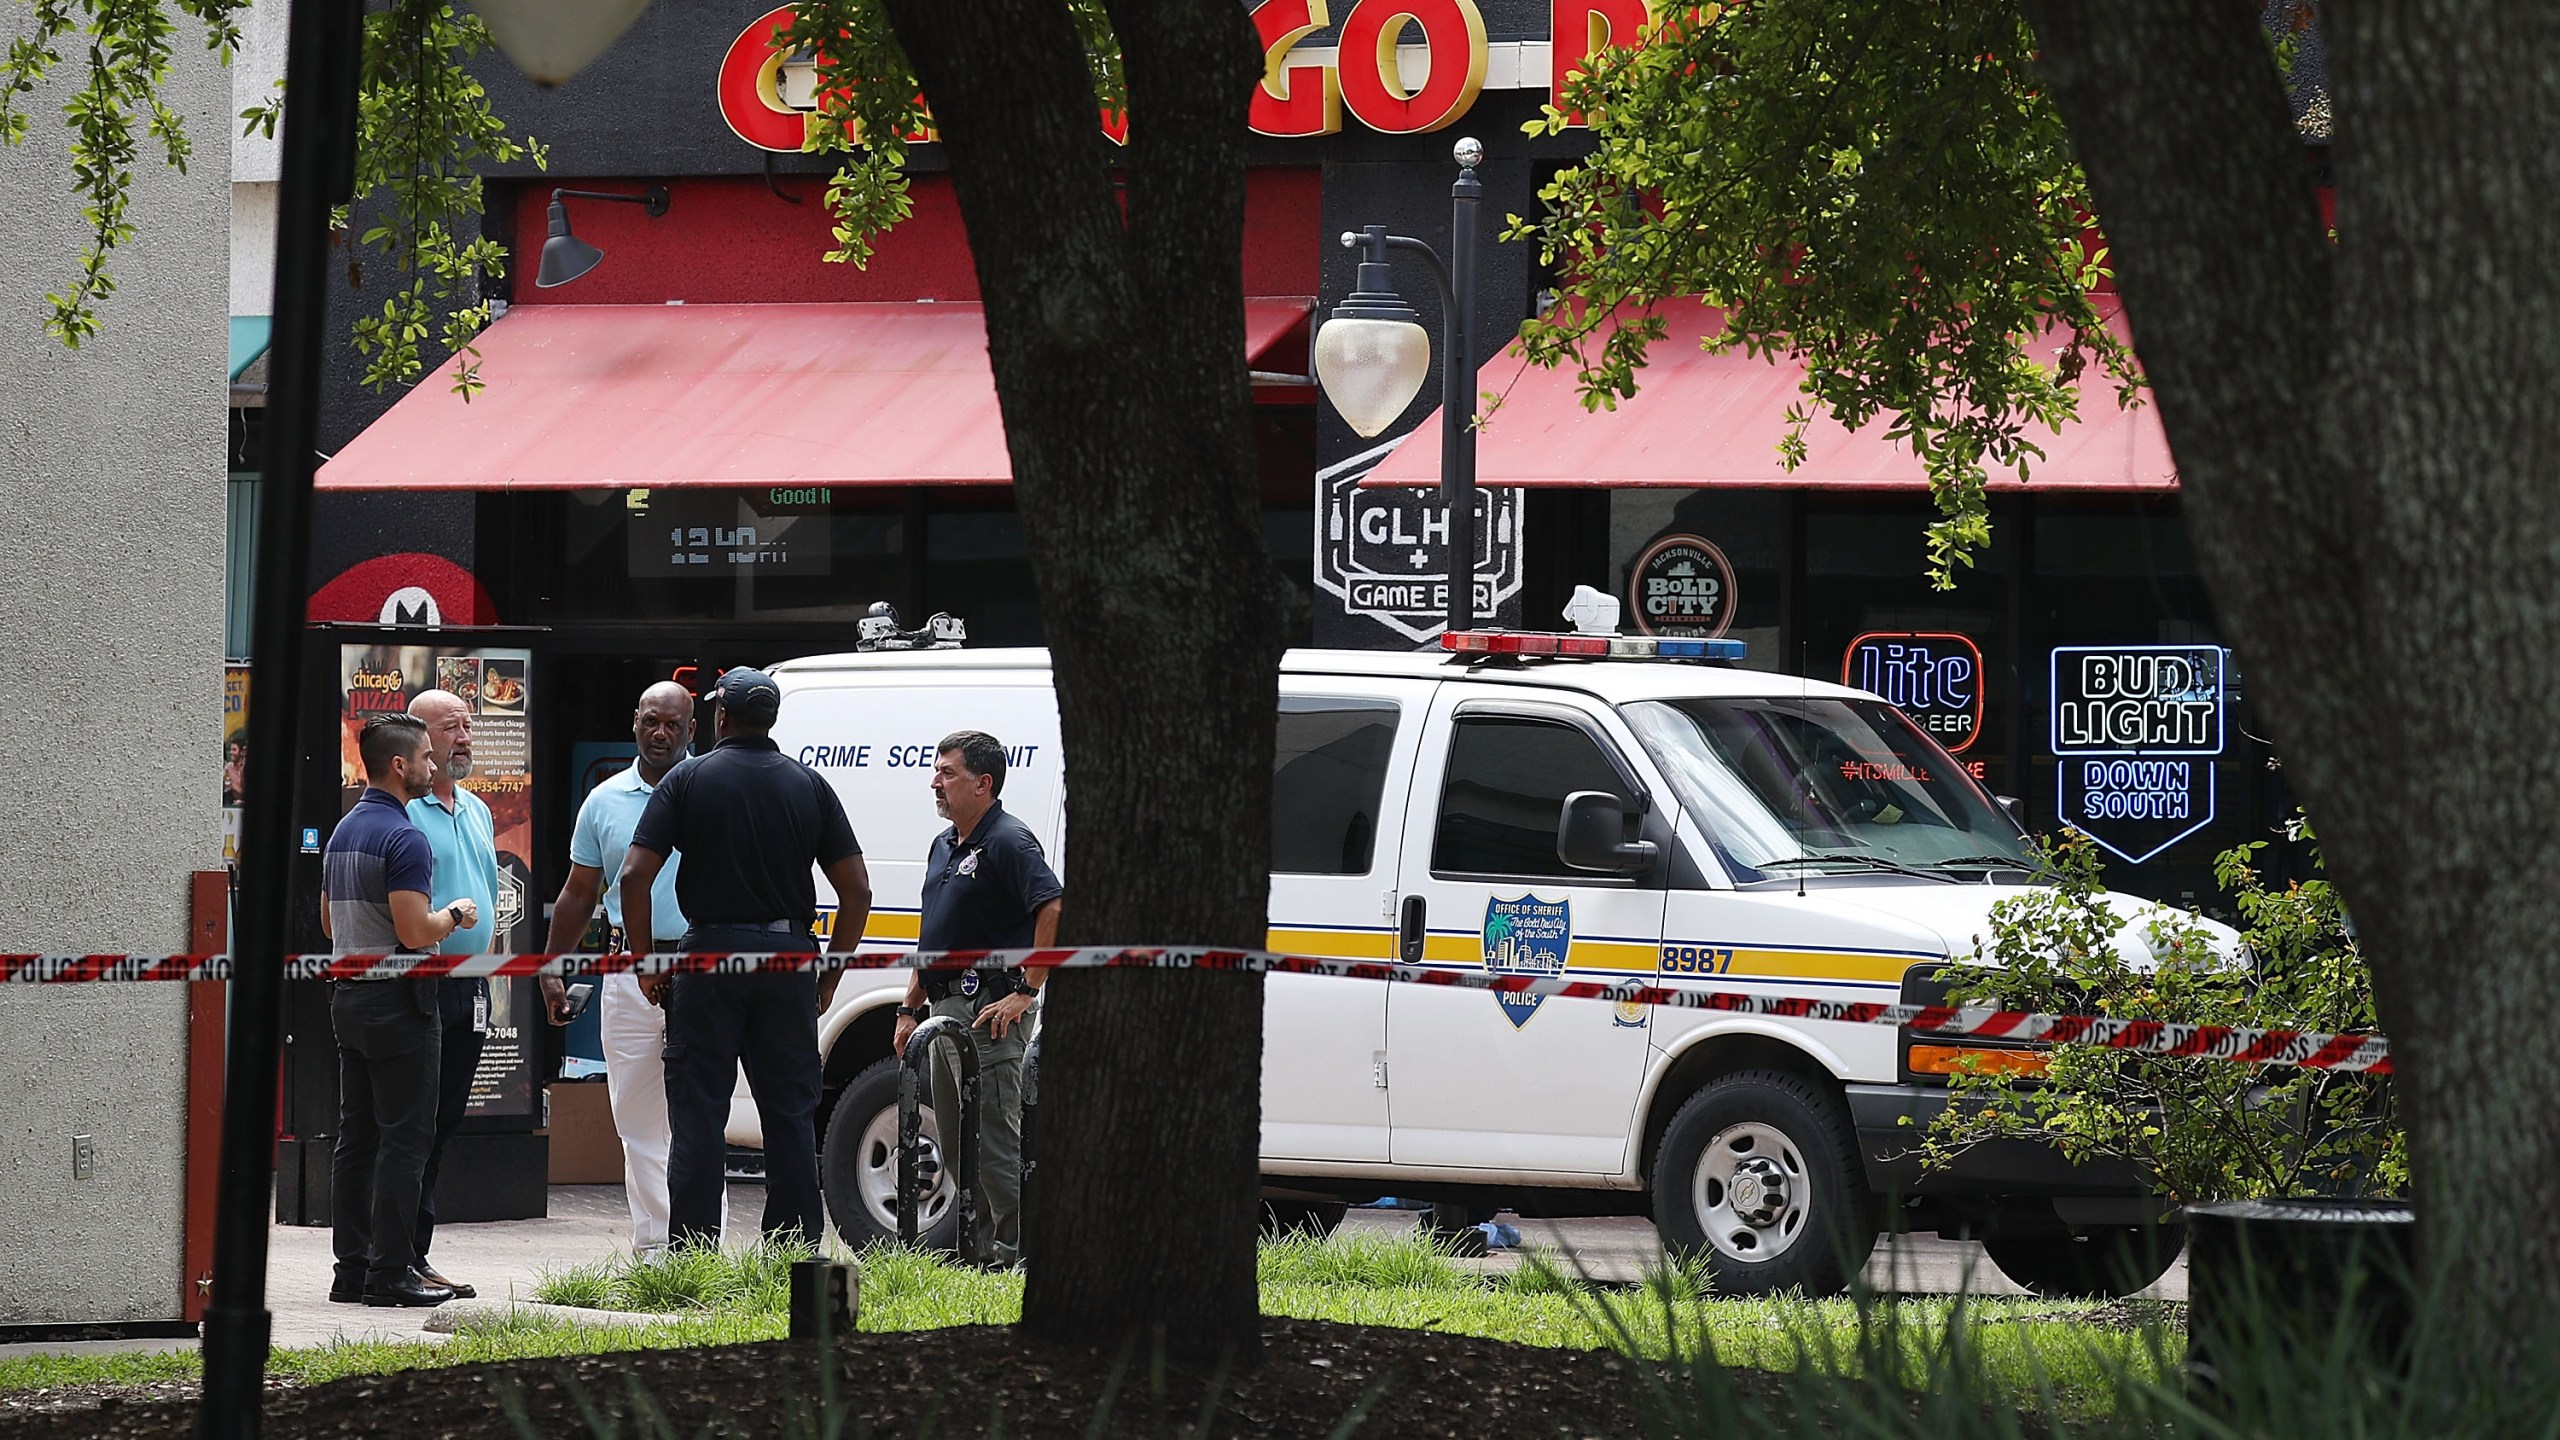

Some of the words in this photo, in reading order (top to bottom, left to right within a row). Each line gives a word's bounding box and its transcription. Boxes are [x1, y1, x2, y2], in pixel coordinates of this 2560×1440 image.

[1360, 507, 1481, 545] GLH
[1652, 548, 1713, 569] JACKSONVILLE
[1353, 584, 1426, 608] GAME
[1433, 584, 1489, 609] BR
[1647, 596, 1718, 614] CITY
[2082, 655, 2192, 698] BUD
[348, 689, 406, 719] pizza
[505, 720, 525, 728] Chicago
[2061, 700, 2215, 744] LIGHT
[505, 730, 525, 738] offering
[505, 740, 525, 748] Chicago
[799, 745, 871, 768] CRIME
[886, 745, 940, 768] SCE
[1003, 745, 1039, 768] NIT
[2084, 760, 2189, 790] DOWN
[461, 782, 524, 792] 904-354-7747
[2084, 791, 2189, 819] SOUTH
[1495, 903, 1520, 914] OFFICE
[1521, 905, 1532, 914] OF
[1532, 905, 1563, 916] SHERIFF
[1510, 916, 1523, 927] The
[1524, 929, 1535, 938] the
[1535, 928, 1559, 939] South
[5, 957, 88, 983] POLICE
[99, 958, 150, 982] LINE
[158, 958, 190, 980] DO
[200, 957, 233, 981] NO
[563, 957, 645, 976] POLICE
[655, 957, 713, 974] LINE
[1662, 948, 1734, 974] 8987
[1502, 991, 1537, 1006] POLICE
[1602, 987, 1672, 1005] POLICE
[2053, 1019, 2119, 1046] POLICE
[2126, 1024, 2166, 1050] LINE
[2172, 1028, 2198, 1053] DO
[2205, 1032, 2241, 1057] NOT
[2249, 1033, 2309, 1062] CROSS
